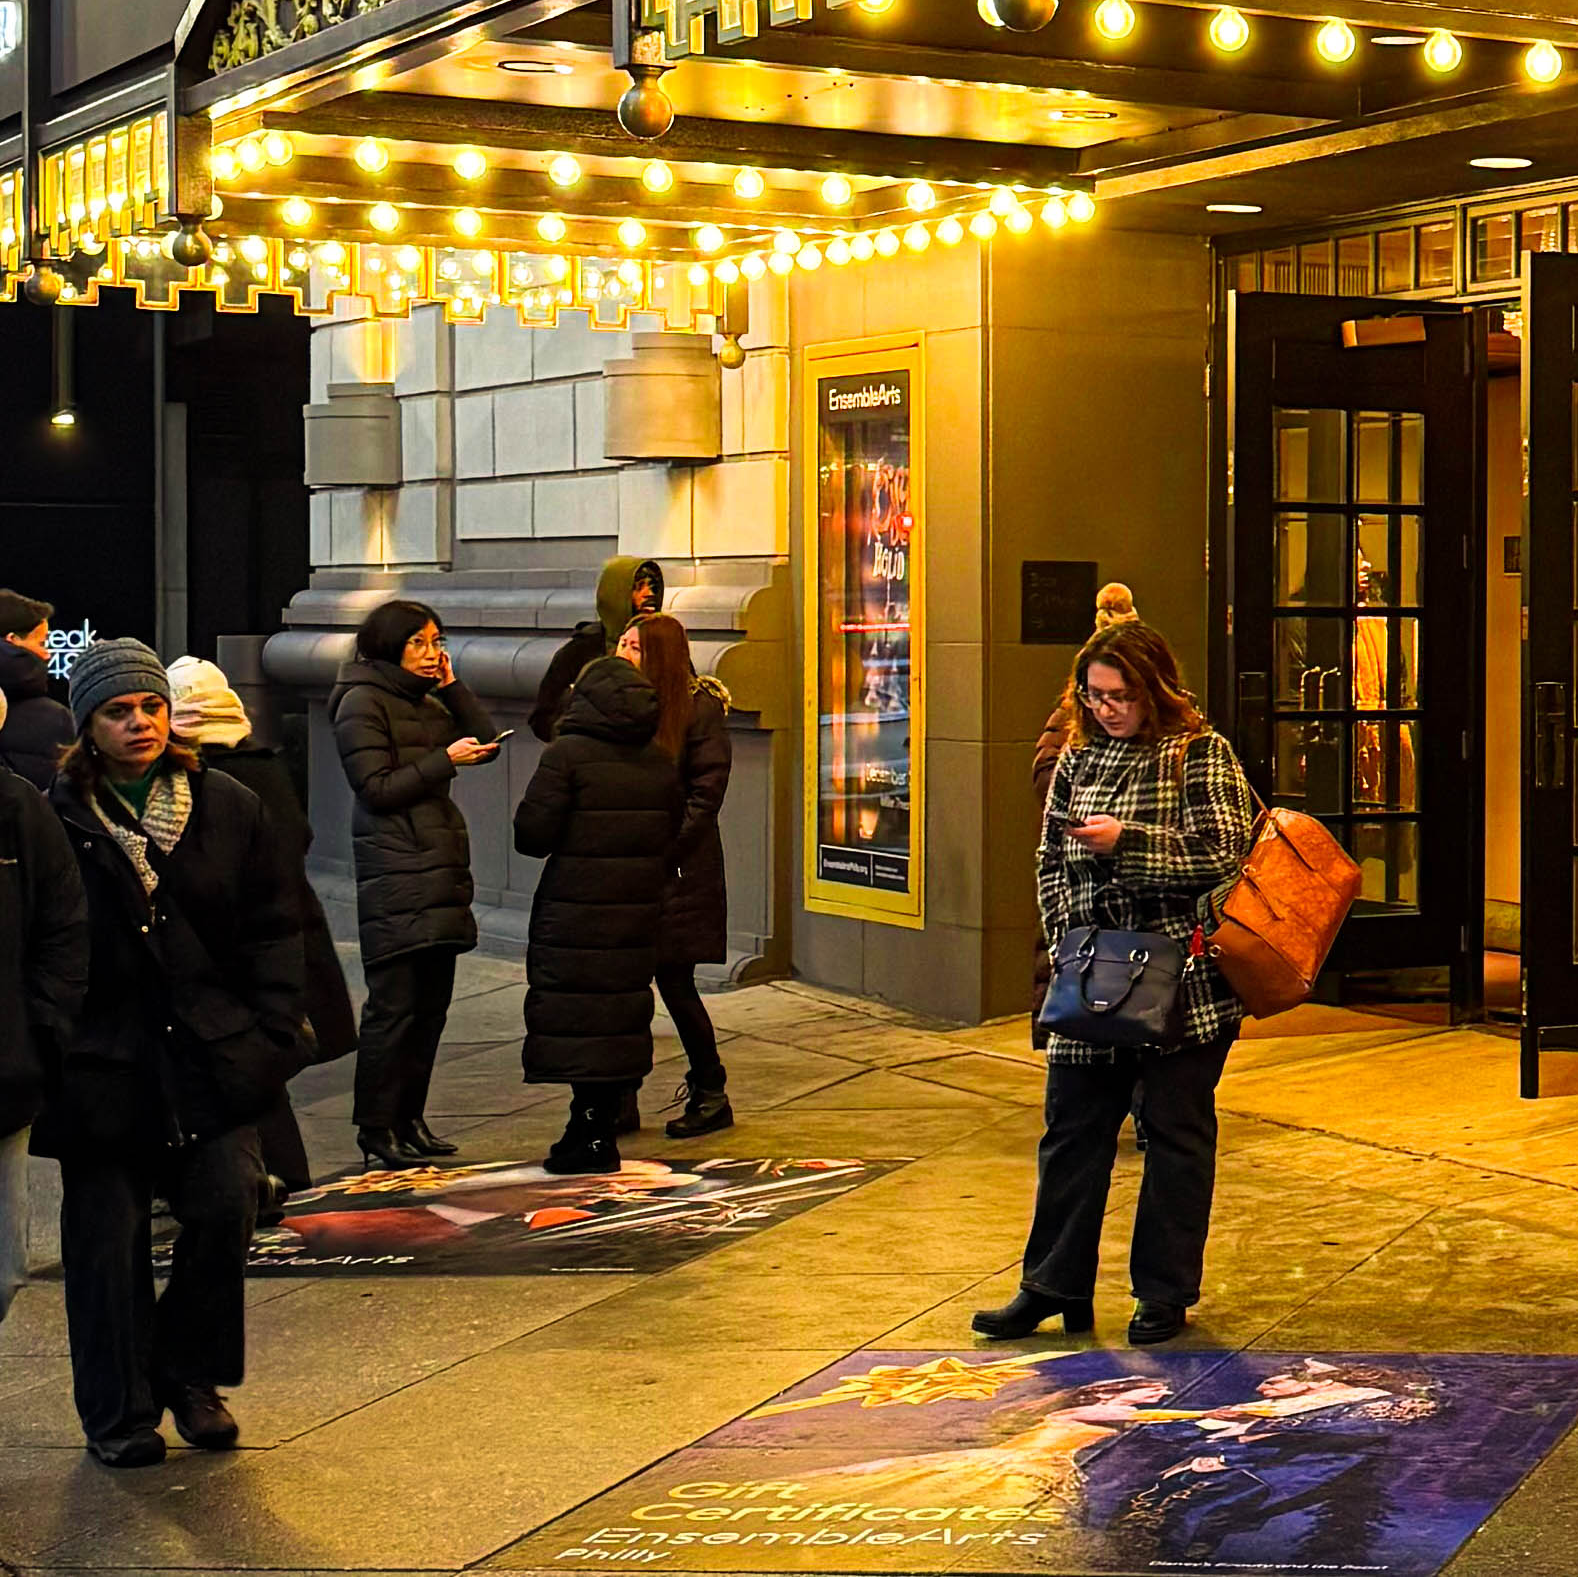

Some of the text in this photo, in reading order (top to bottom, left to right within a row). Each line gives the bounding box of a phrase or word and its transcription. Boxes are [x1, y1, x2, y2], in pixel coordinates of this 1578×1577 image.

[667, 1480, 810, 1501] Gift
[631, 1502, 1066, 1522] Certificates
[581, 1526, 1048, 1546] EnsembleArts
[553, 1547, 673, 1563] Philly
